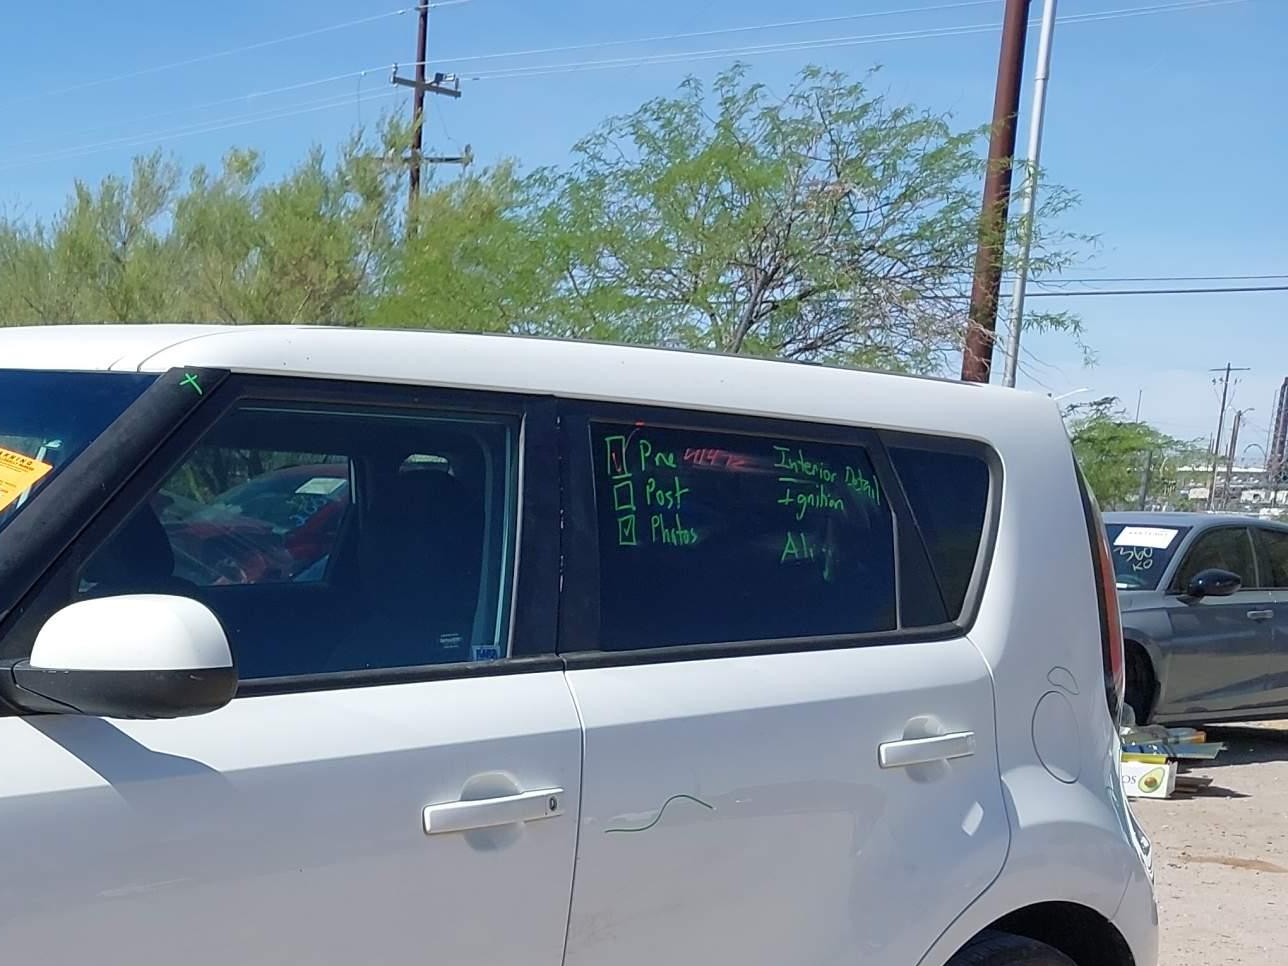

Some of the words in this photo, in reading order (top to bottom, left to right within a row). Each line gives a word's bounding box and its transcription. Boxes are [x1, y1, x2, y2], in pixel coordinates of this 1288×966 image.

[639, 439, 678, 472] Pre
[773, 445, 837, 482] Interior
[646, 476, 689, 509] Post
[777, 478, 844, 521] Ignition
[651, 513, 698, 546] Photos
